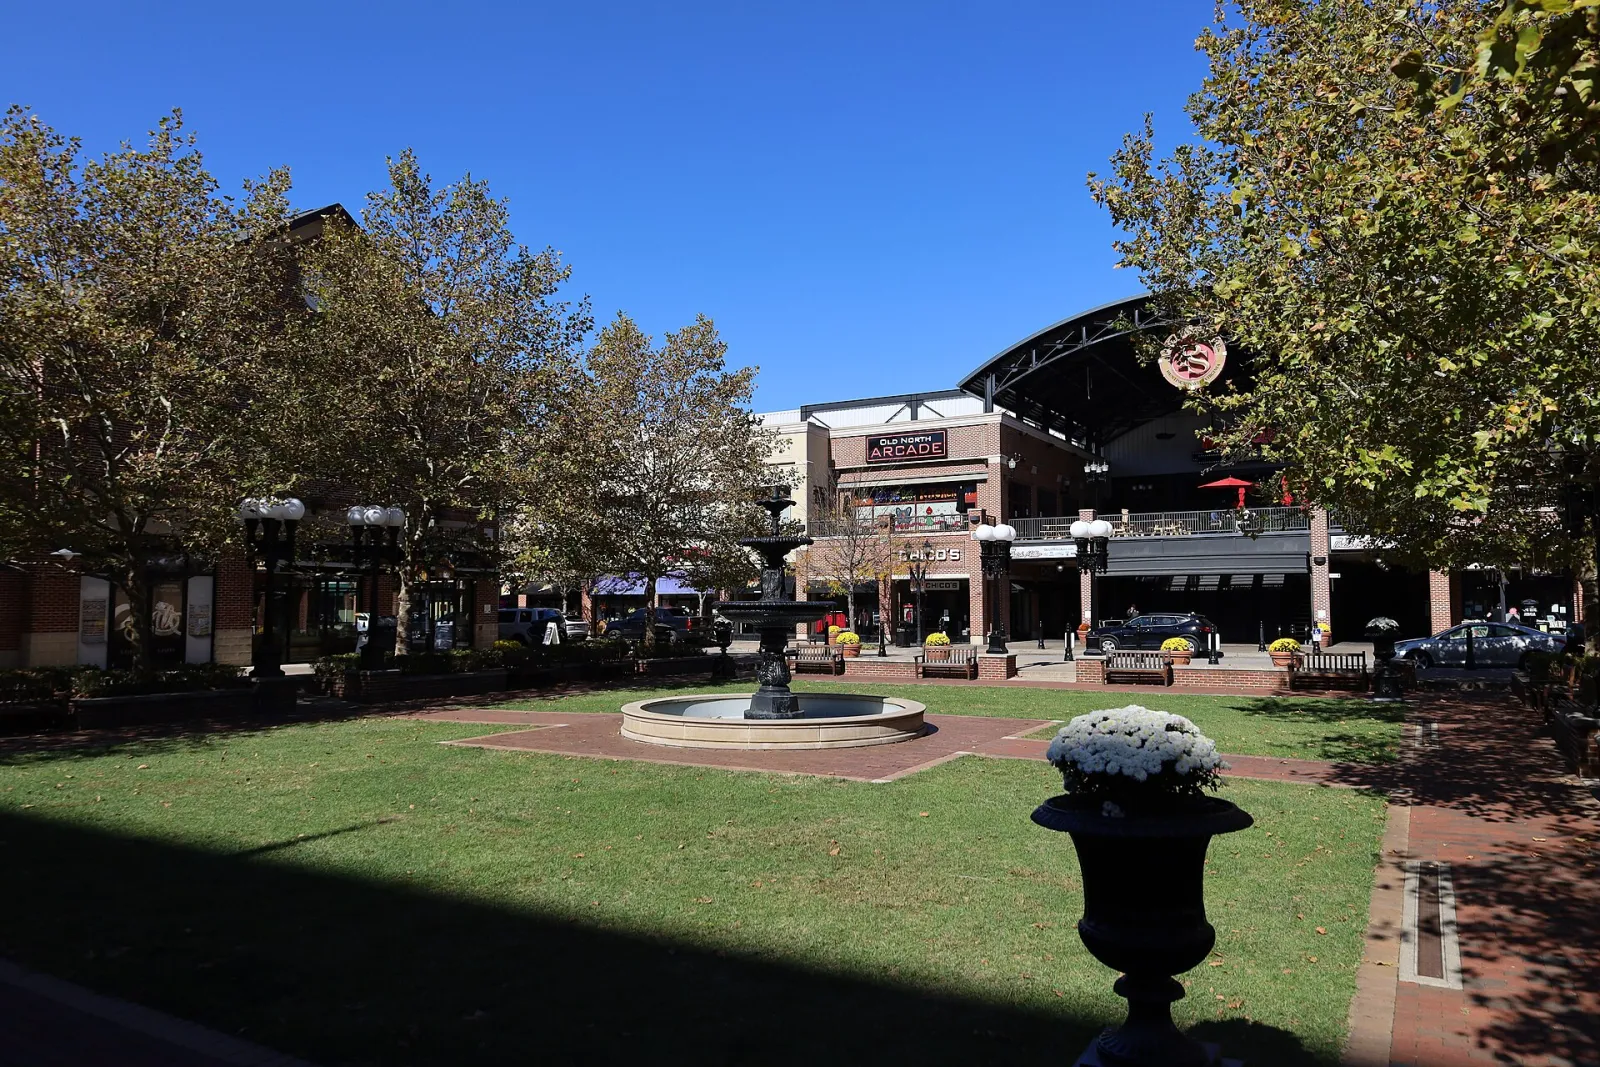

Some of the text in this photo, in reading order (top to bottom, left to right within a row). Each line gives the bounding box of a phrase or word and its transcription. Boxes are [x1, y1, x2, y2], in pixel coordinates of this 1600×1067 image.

[879, 435, 932, 446] OLD NORTH
[870, 442, 942, 459] ARCADE
